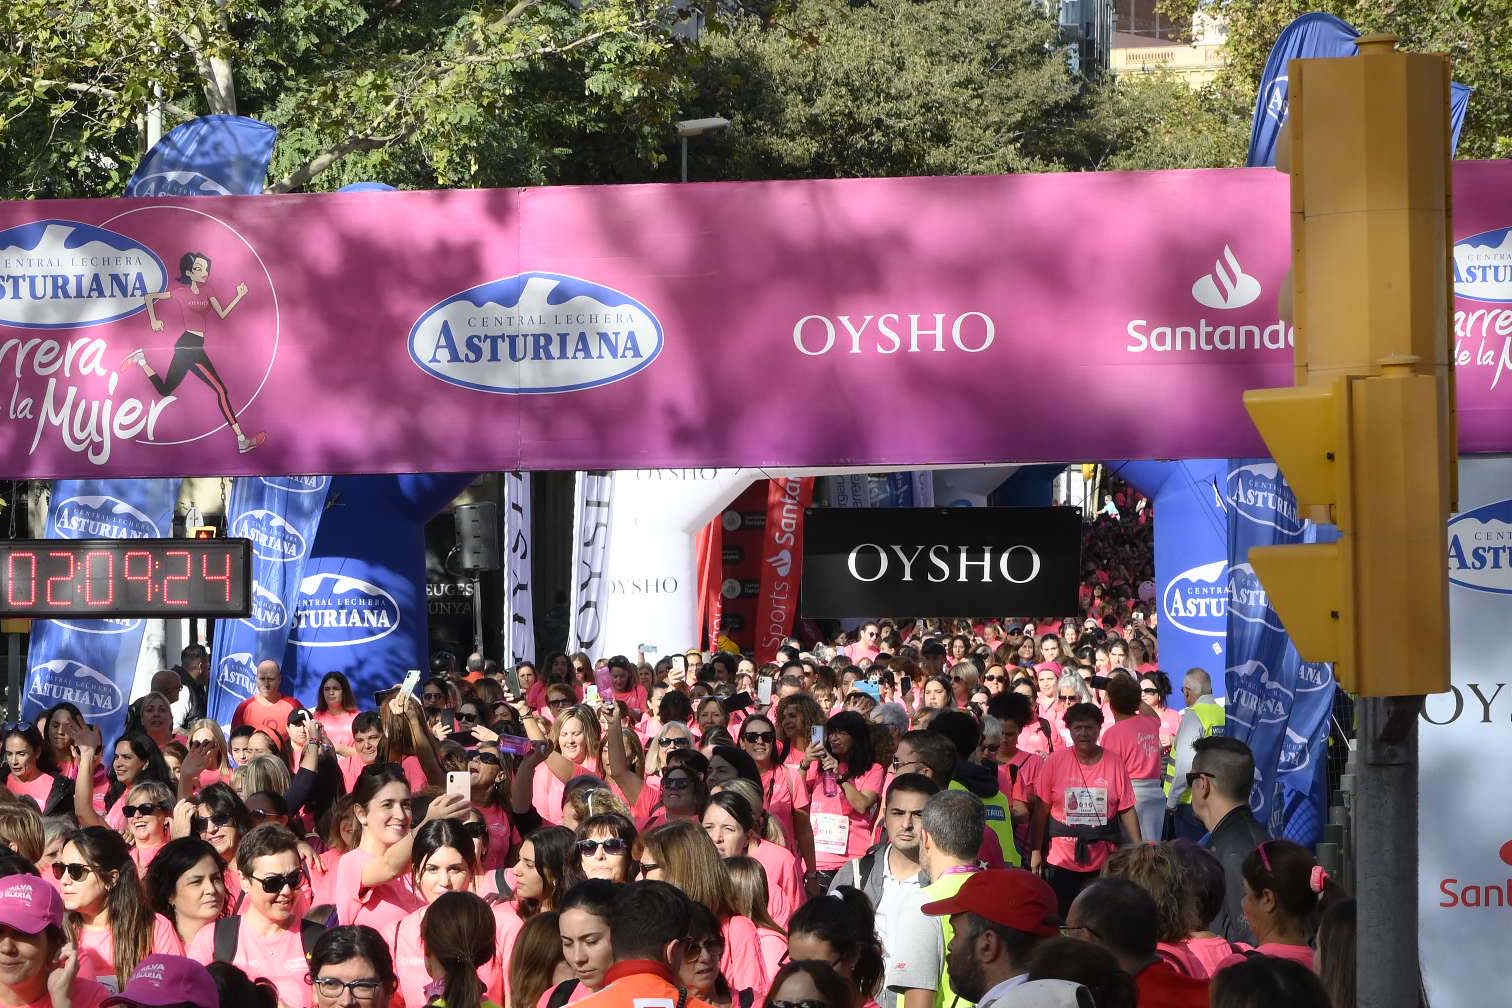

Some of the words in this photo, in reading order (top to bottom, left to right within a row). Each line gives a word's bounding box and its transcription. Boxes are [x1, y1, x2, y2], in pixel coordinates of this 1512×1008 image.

[71, 255, 144, 267] LECHERA
[468, 314, 547, 327] CENTRAL
[554, 312, 635, 325] LECHERA
[792, 311, 996, 355] OYSHO
[428, 319, 644, 364] ASTURIANA
[1476, 338, 1494, 366] la
[9, 379, 35, 419] la
[29, 371, 178, 465] Mujer
[7, 551, 231, 606] 02:09:24
[847, 543, 1041, 584] OYSHO
[1170, 589, 1228, 617] ASTU
